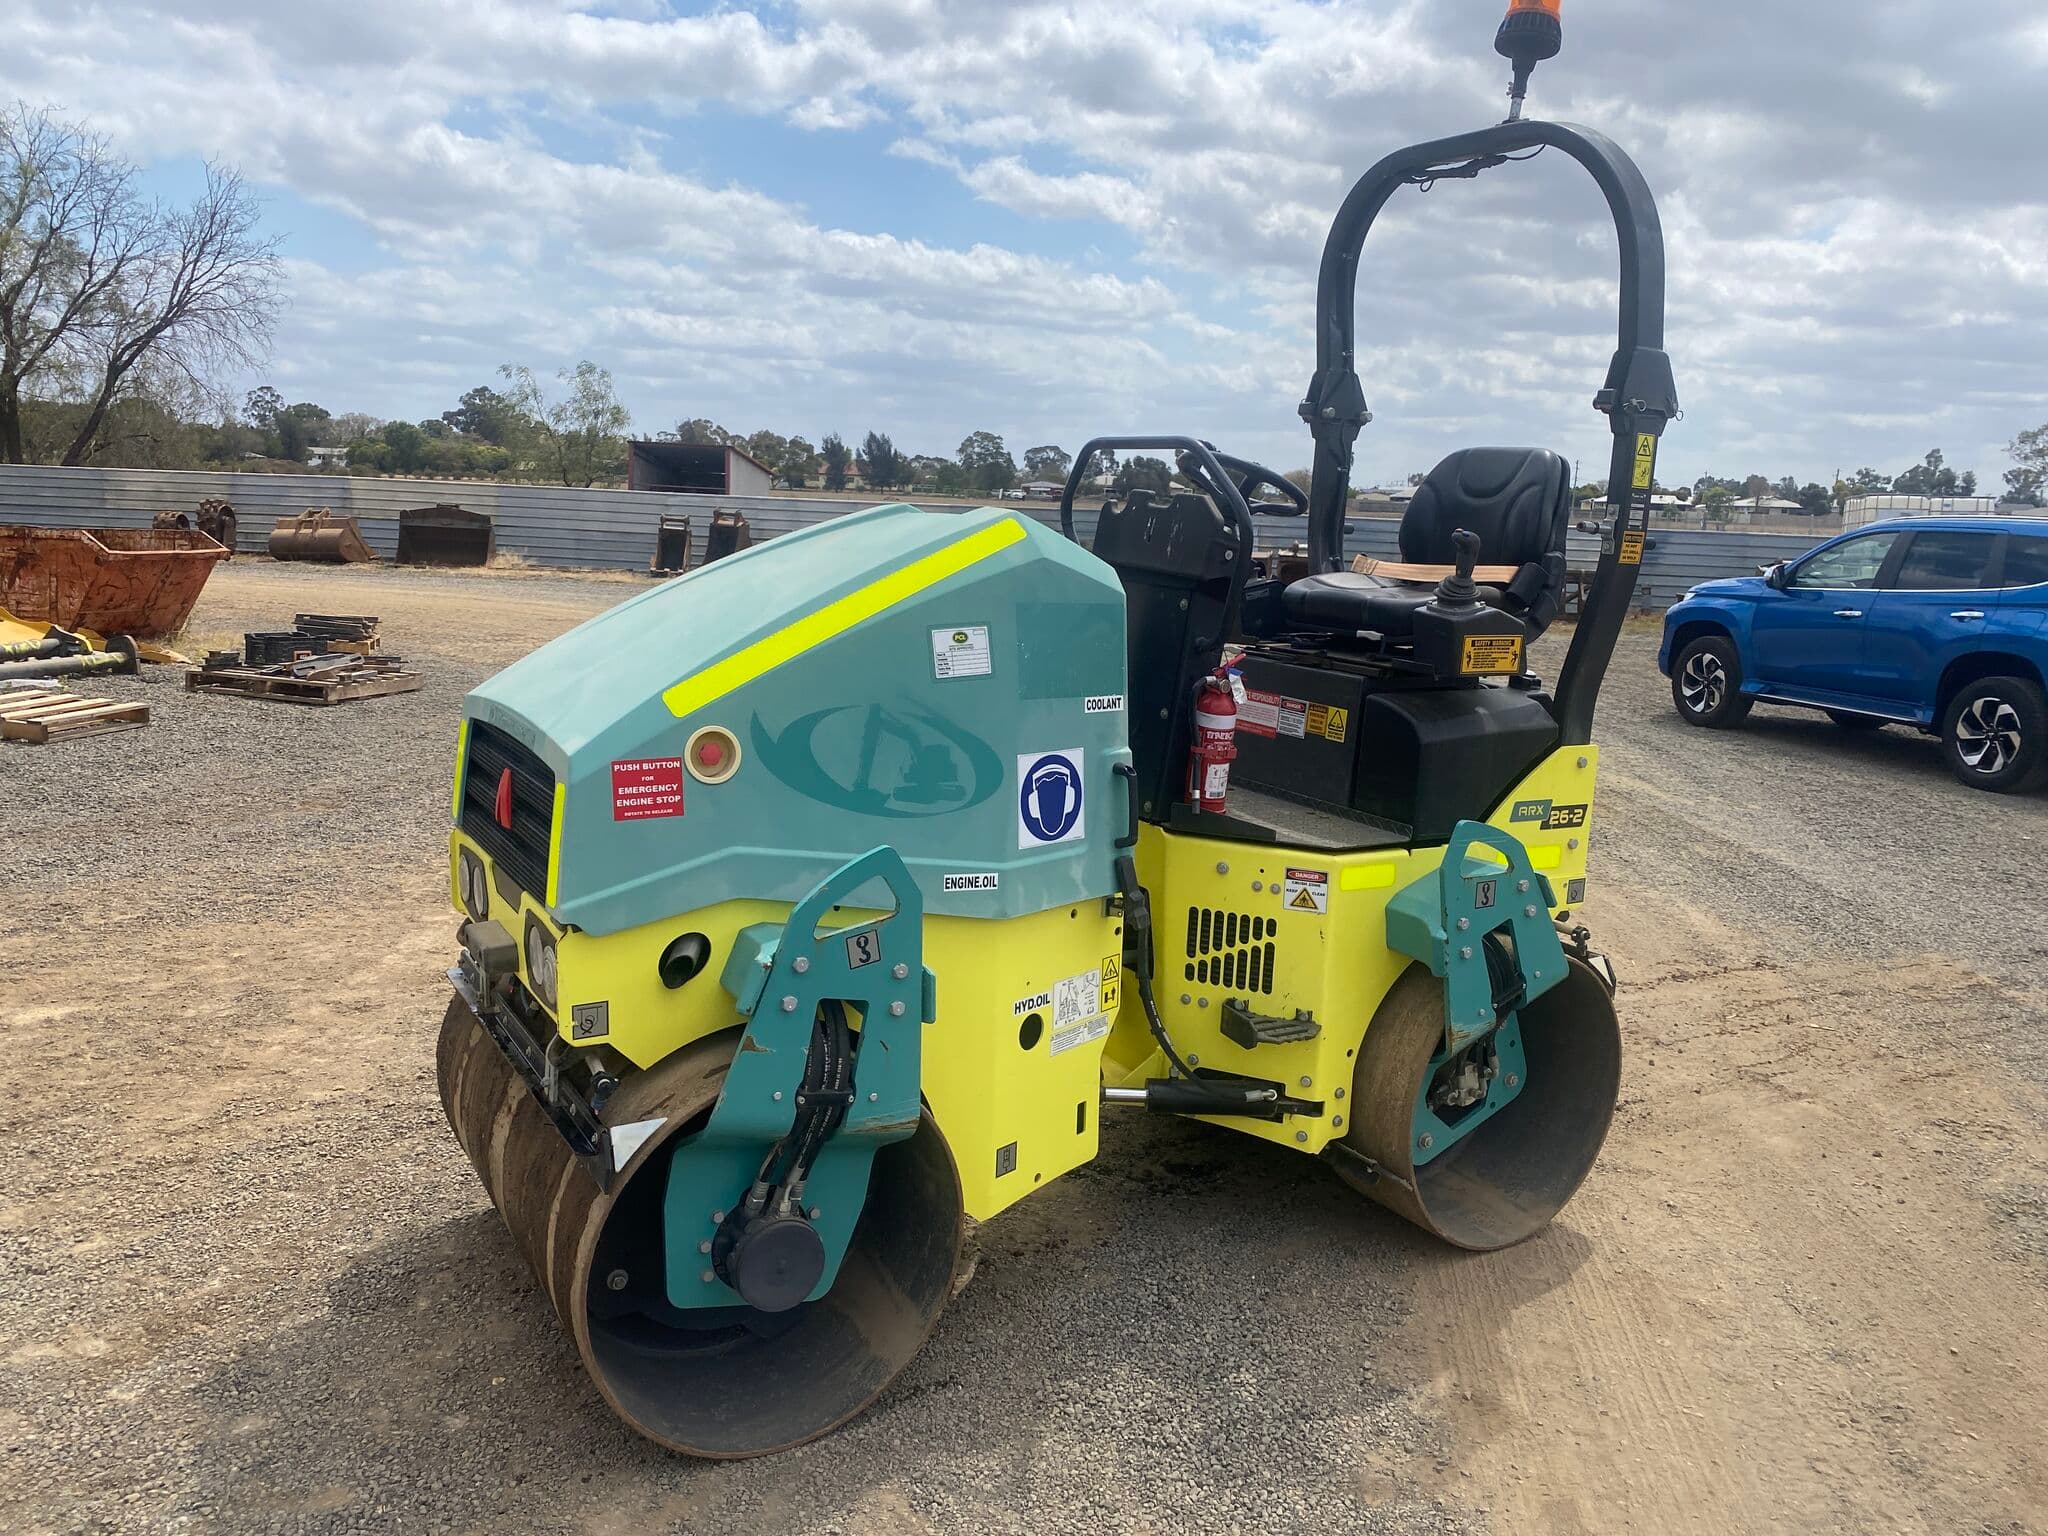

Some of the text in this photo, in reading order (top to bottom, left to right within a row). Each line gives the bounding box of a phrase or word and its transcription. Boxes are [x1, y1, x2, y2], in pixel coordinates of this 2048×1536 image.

[1086, 697, 1122, 711] COOLANT
[614, 761, 680, 772] PUSH BUTTON
[618, 783, 679, 795] EMERGENCY
[616, 795, 681, 807] ENGINE STOP
[1518, 804, 1583, 825] ARX 26-2
[945, 875, 997, 890] ENGINE.OIL
[1295, 872, 1319, 880] DANGER
[1014, 993, 1051, 1015] HYD.OIL
